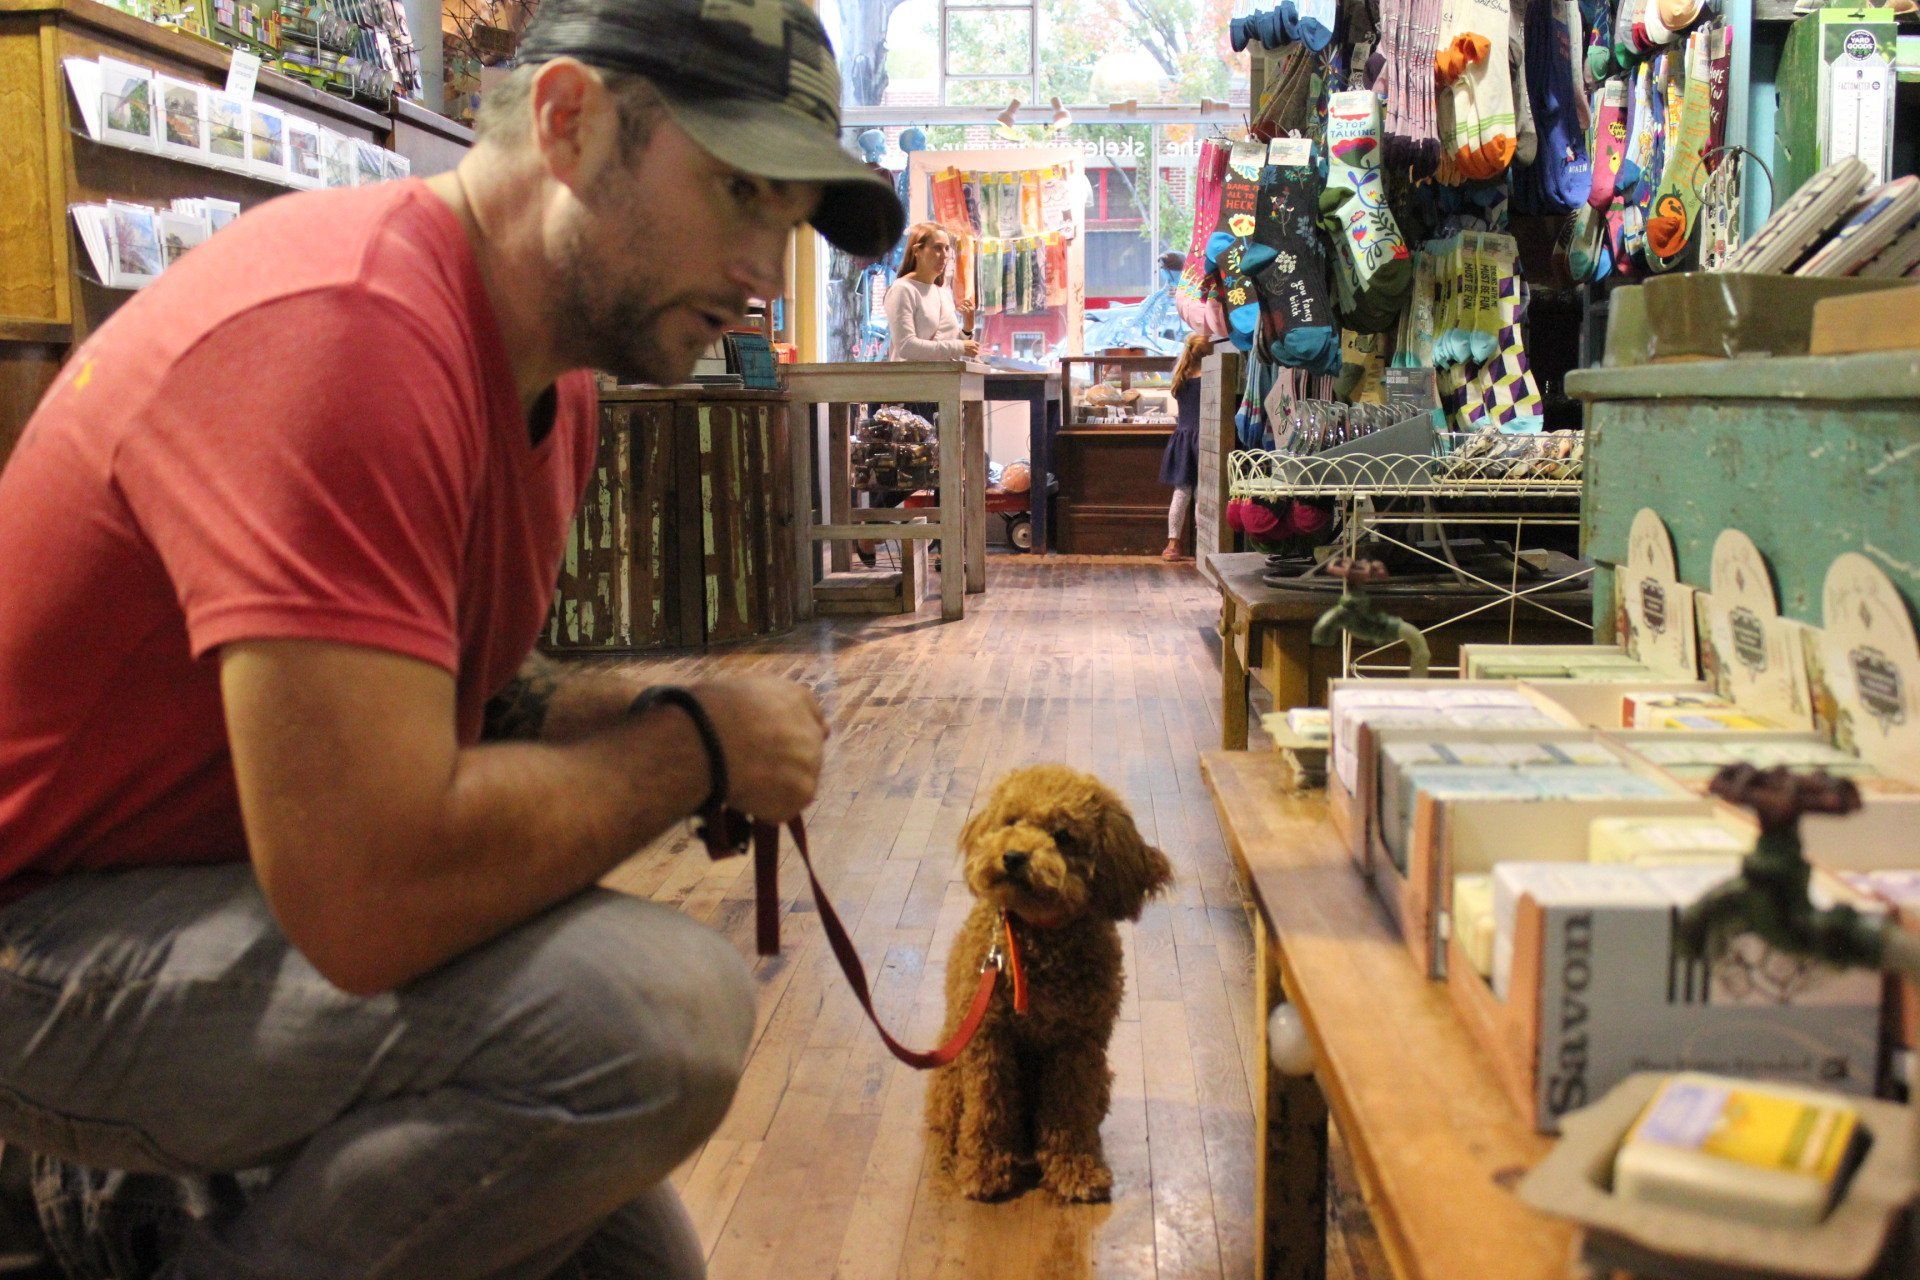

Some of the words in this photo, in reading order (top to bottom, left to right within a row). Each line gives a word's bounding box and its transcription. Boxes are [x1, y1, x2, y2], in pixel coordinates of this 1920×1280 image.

[1335, 121, 1367, 129] STOP
[1330, 128, 1376, 138] TALKING
[1568, 163, 1588, 173] AGAIN
[1227, 191, 1242, 199] ALL
[1245, 192, 1256, 200] TO
[1225, 199, 1256, 211] HECK
[1464, 263, 1474, 283] MUST
[1480, 264, 1490, 284] MUST
[1464, 284, 1474, 294] BE
[1480, 285, 1490, 295] BE
[1290, 280, 1307, 296] you
[1301, 298, 1313, 322] fancy
[1290, 294, 1301, 317] bitch
[1549, 910, 1592, 1118] Savon
